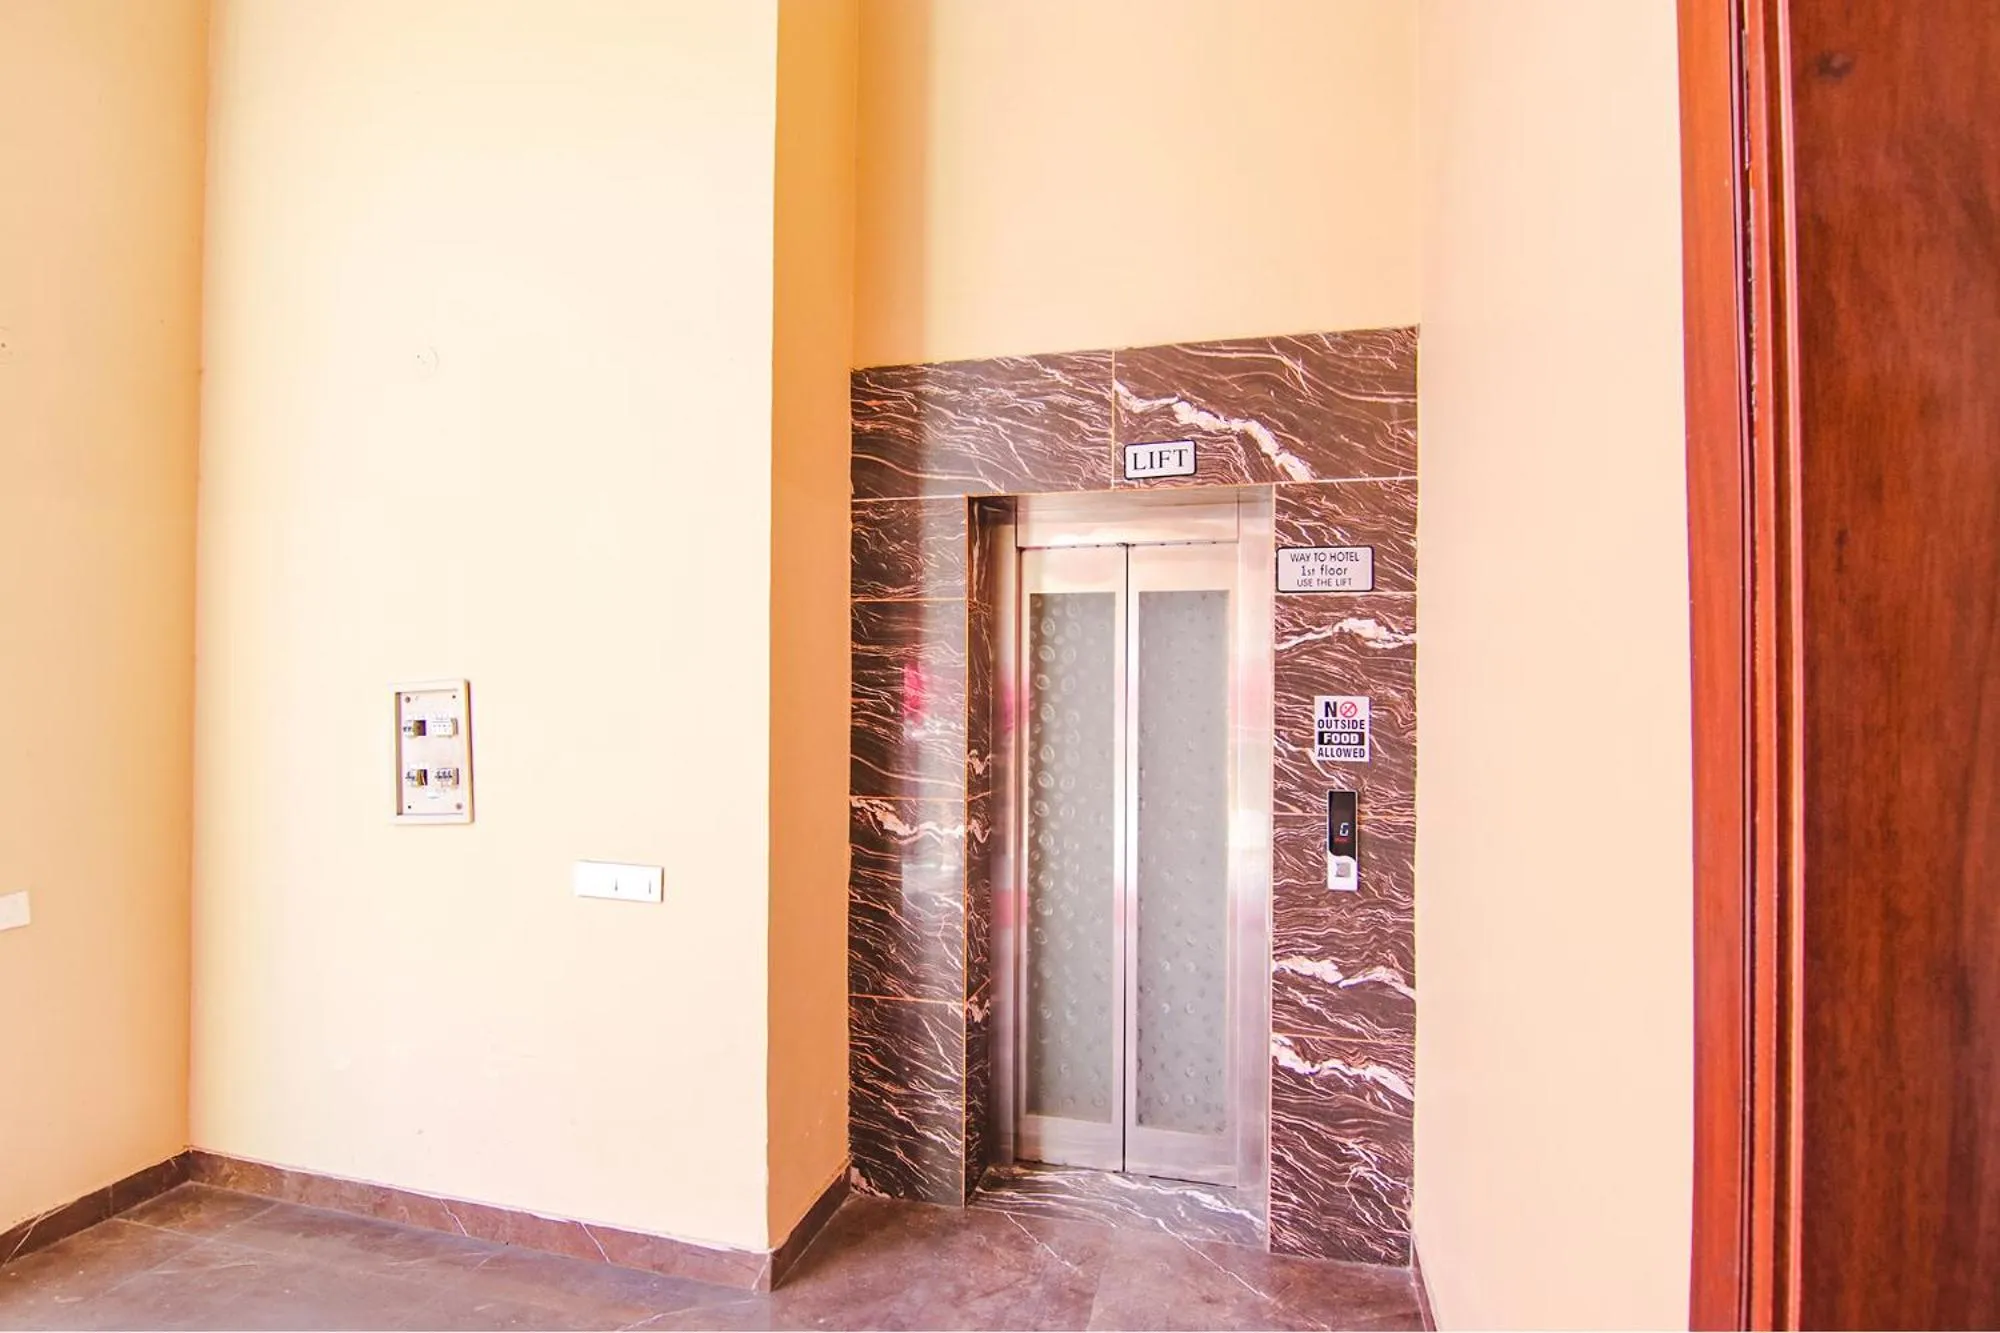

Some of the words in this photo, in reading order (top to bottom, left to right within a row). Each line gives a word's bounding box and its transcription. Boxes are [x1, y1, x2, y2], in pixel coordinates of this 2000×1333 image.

[1132, 448, 1189, 471] LIFT
[1290, 553, 1312, 562] WAY
[1314, 552, 1327, 562] TO
[1330, 551, 1360, 562] HOTEL
[1301, 565, 1315, 576] 1st
[1320, 564, 1348, 576] floor
[1297, 578, 1313, 587] USE
[1316, 578, 1332, 587] THE
[1335, 578, 1352, 587] LIFT
[1317, 719, 1365, 729] OUTSIDE
[1323, 732, 1359, 744] FOOD
[1317, 747, 1365, 758] ALLOWED
